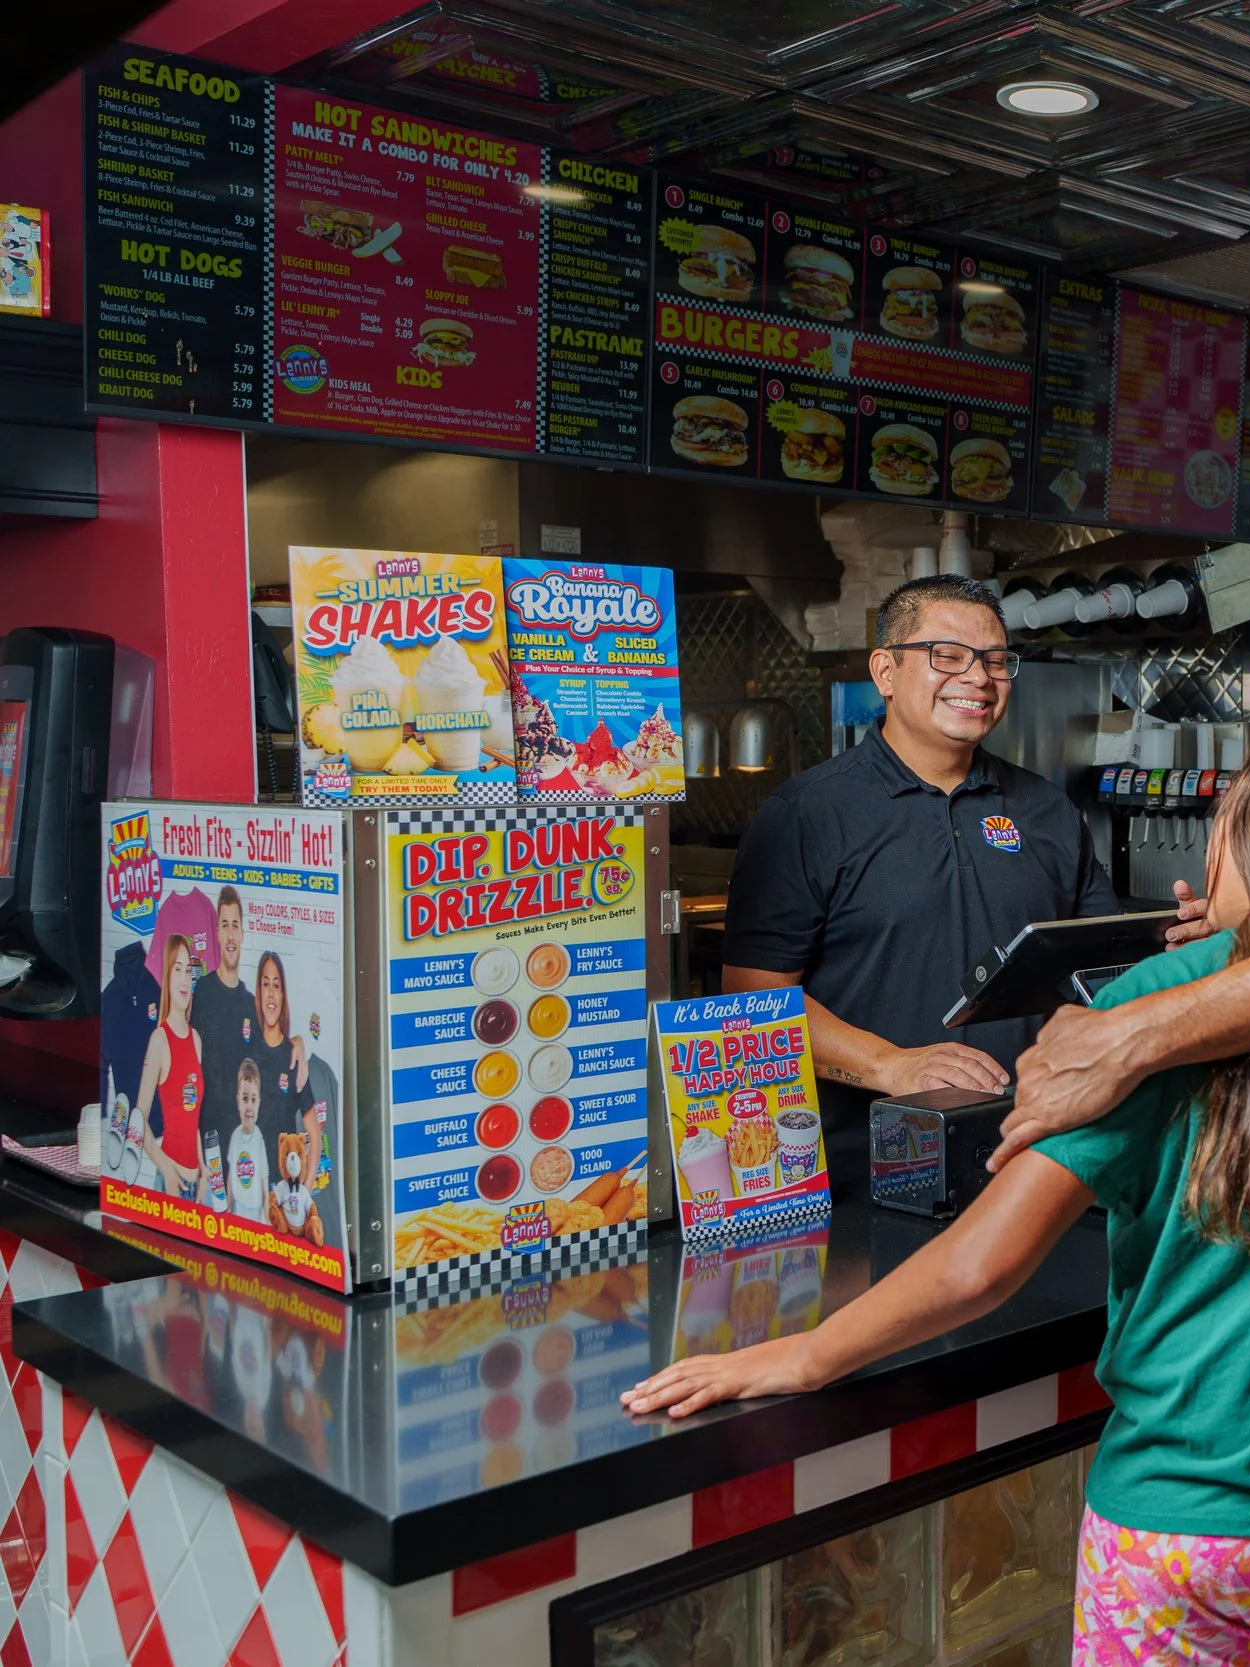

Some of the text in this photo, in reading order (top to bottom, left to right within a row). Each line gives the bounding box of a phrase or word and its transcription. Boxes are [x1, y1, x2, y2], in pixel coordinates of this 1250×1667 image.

[123, 58, 240, 102] SEAFOOD
[98, 85, 120, 100] FISH
[132, 92, 160, 108] CHIPS
[98, 114, 120, 128] FISH
[132, 121, 170, 138] SHRIMP
[172, 128, 206, 146] BASKET
[230, 114, 256, 128] 11.29
[315, 100, 516, 166] HOT SANDWICHES
[228, 142, 254, 156] 11.29
[292, 122, 530, 186] MAKE IT A COMBO FOR ONLY 4.20
[98, 158, 175, 182] SHRIMP BASKET
[558, 159, 639, 194] CHICKEN
[228, 184, 254, 198] 11.29
[98, 188, 174, 213] FISH SANDWICH
[234, 214, 255, 227] 9.39
[426, 213, 488, 234] GRILLED CHEESE
[518, 230, 535, 241] 3.99
[121, 239, 244, 278] HOT DOGS
[281, 254, 351, 276] VEGGIE BURGER
[142, 269, 215, 290] 1/4 LB ALL BEEF
[395, 276, 414, 287] 8.49
[425, 289, 470, 306] SLOPPY JOE
[516, 305, 534, 316] 5.99
[550, 324, 644, 357] PASTRAMI
[660, 306, 800, 360] BURGERS
[98, 348, 157, 365] CHEESE DOG
[126, 370, 160, 384] CHEESE
[162, 374, 183, 386] DOG
[233, 364, 254, 374] 5.79
[396, 364, 442, 390] KIDS
[232, 382, 252, 393] 5.99
[339, 574, 460, 602] SUMMER
[546, 576, 623, 598] Banana
[510, 583, 658, 634] Royale
[307, 591, 492, 646] SHAKES
[512, 632, 656, 650] VANILLA SLICED
[529, 644, 666, 664] CREAM & BANANAS
[526, 664, 542, 672] Plus
[542, 665, 560, 673] Your
[561, 666, 586, 674] Choice
[586, 666, 594, 674] of
[596, 667, 616, 676] Syrup
[625, 668, 652, 676] Topping
[560, 680, 629, 689] SYRUP TOPPING
[352, 690, 388, 710] PIÑA
[342, 710, 400, 730] COLADA
[416, 712, 490, 732] HORCHATA
[413, 784, 446, 792] TODAY!
[163, 814, 333, 867] Fresh Fits Sizzlin' Hot!
[409, 817, 625, 888] DIP. DUNK.
[173, 864, 334, 891] ADULTS TEENS KIDS BABIES GIFTS
[598, 866, 631, 884] 75¢
[409, 868, 594, 938] DRIZZLE.
[496, 907, 636, 940] Sauces Make Every Bite Even Better!
[576, 946, 613, 958] LENNY'S
[424, 959, 465, 972] LENNY'S
[576, 958, 623, 972] FRY SAUCE
[404, 972, 465, 990] MAYO SAUCE
[578, 996, 608, 1010] HONEY
[674, 992, 790, 1024] It's Back Baby!
[414, 1012, 466, 1028] BARBECUE
[578, 1008, 620, 1022] MUSTARD
[668, 1026, 804, 1074] 1/2 PRICE
[578, 1056, 636, 1074] RANCH SAUCE
[684, 1058, 800, 1094] HAPPY HOUR
[734, 1091, 756, 1100] EVERYDAY
[778, 1092, 807, 1108] DRINK
[732, 1100, 762, 1114] 2-5 PM
[686, 1108, 720, 1125] SHAKE
[424, 1119, 468, 1136] BUFFALO
[580, 1148, 602, 1160] 1000
[580, 1160, 612, 1175] ISLAND
[742, 1168, 768, 1180] REG SIZE
[744, 1176, 770, 1192] FRIES
[106, 1185, 342, 1278] Exclusive Merch @ LennysBurger.com
